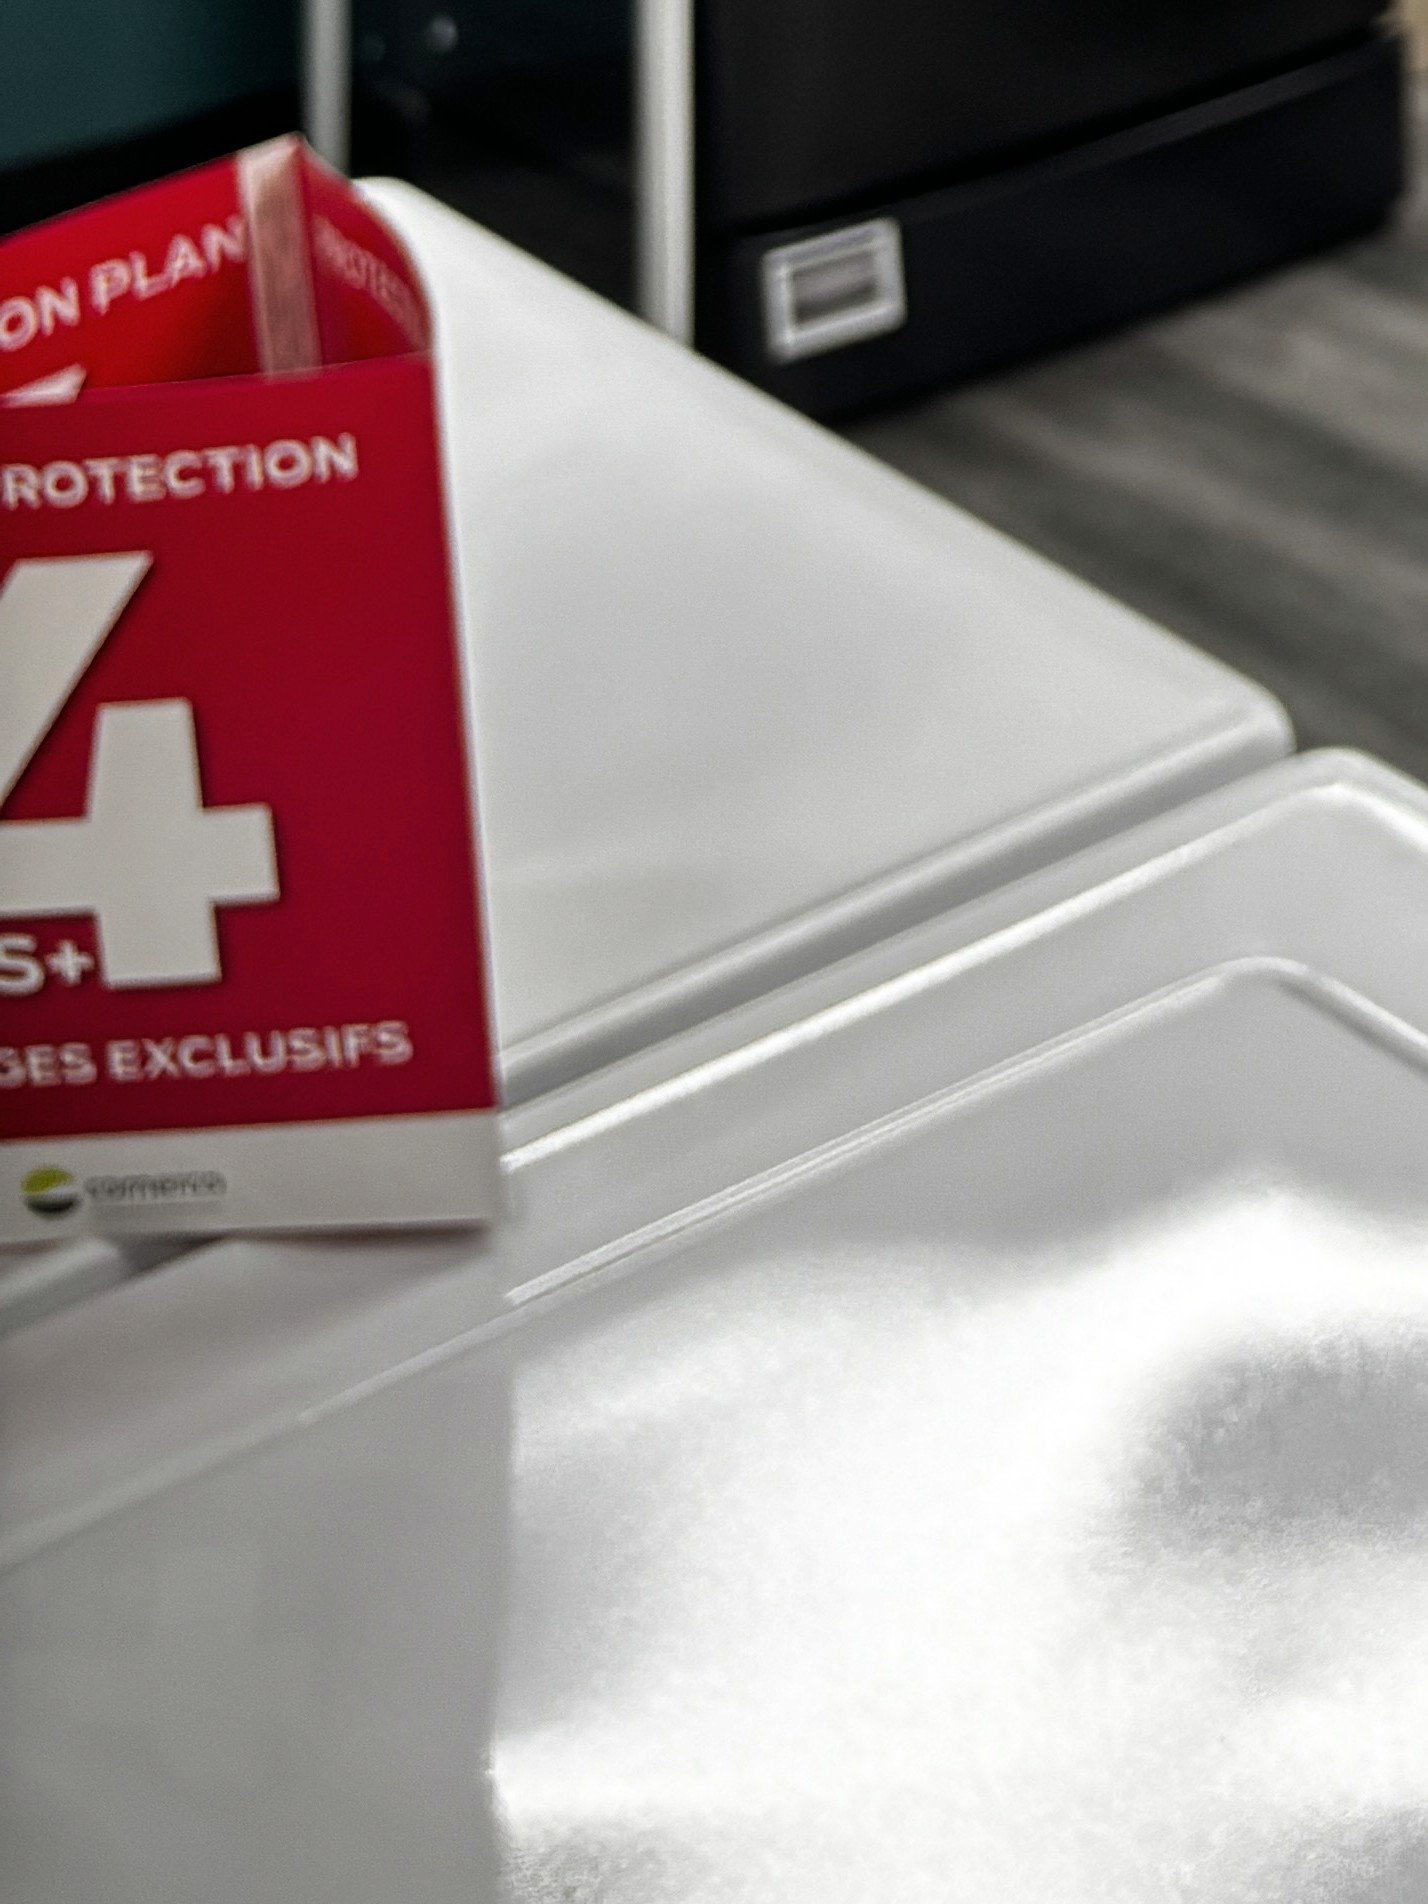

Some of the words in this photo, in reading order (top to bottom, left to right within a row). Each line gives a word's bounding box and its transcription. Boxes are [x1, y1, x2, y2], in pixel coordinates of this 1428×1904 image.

[0, 276, 81, 353] ON
[88, 213, 247, 317] PLAN
[0, 432, 359, 511] ROTECTION
[0, 931, 96, 996] S+
[0, 1040, 98, 1090] GES
[105, 1018, 414, 1084] EXCLUSIFS
